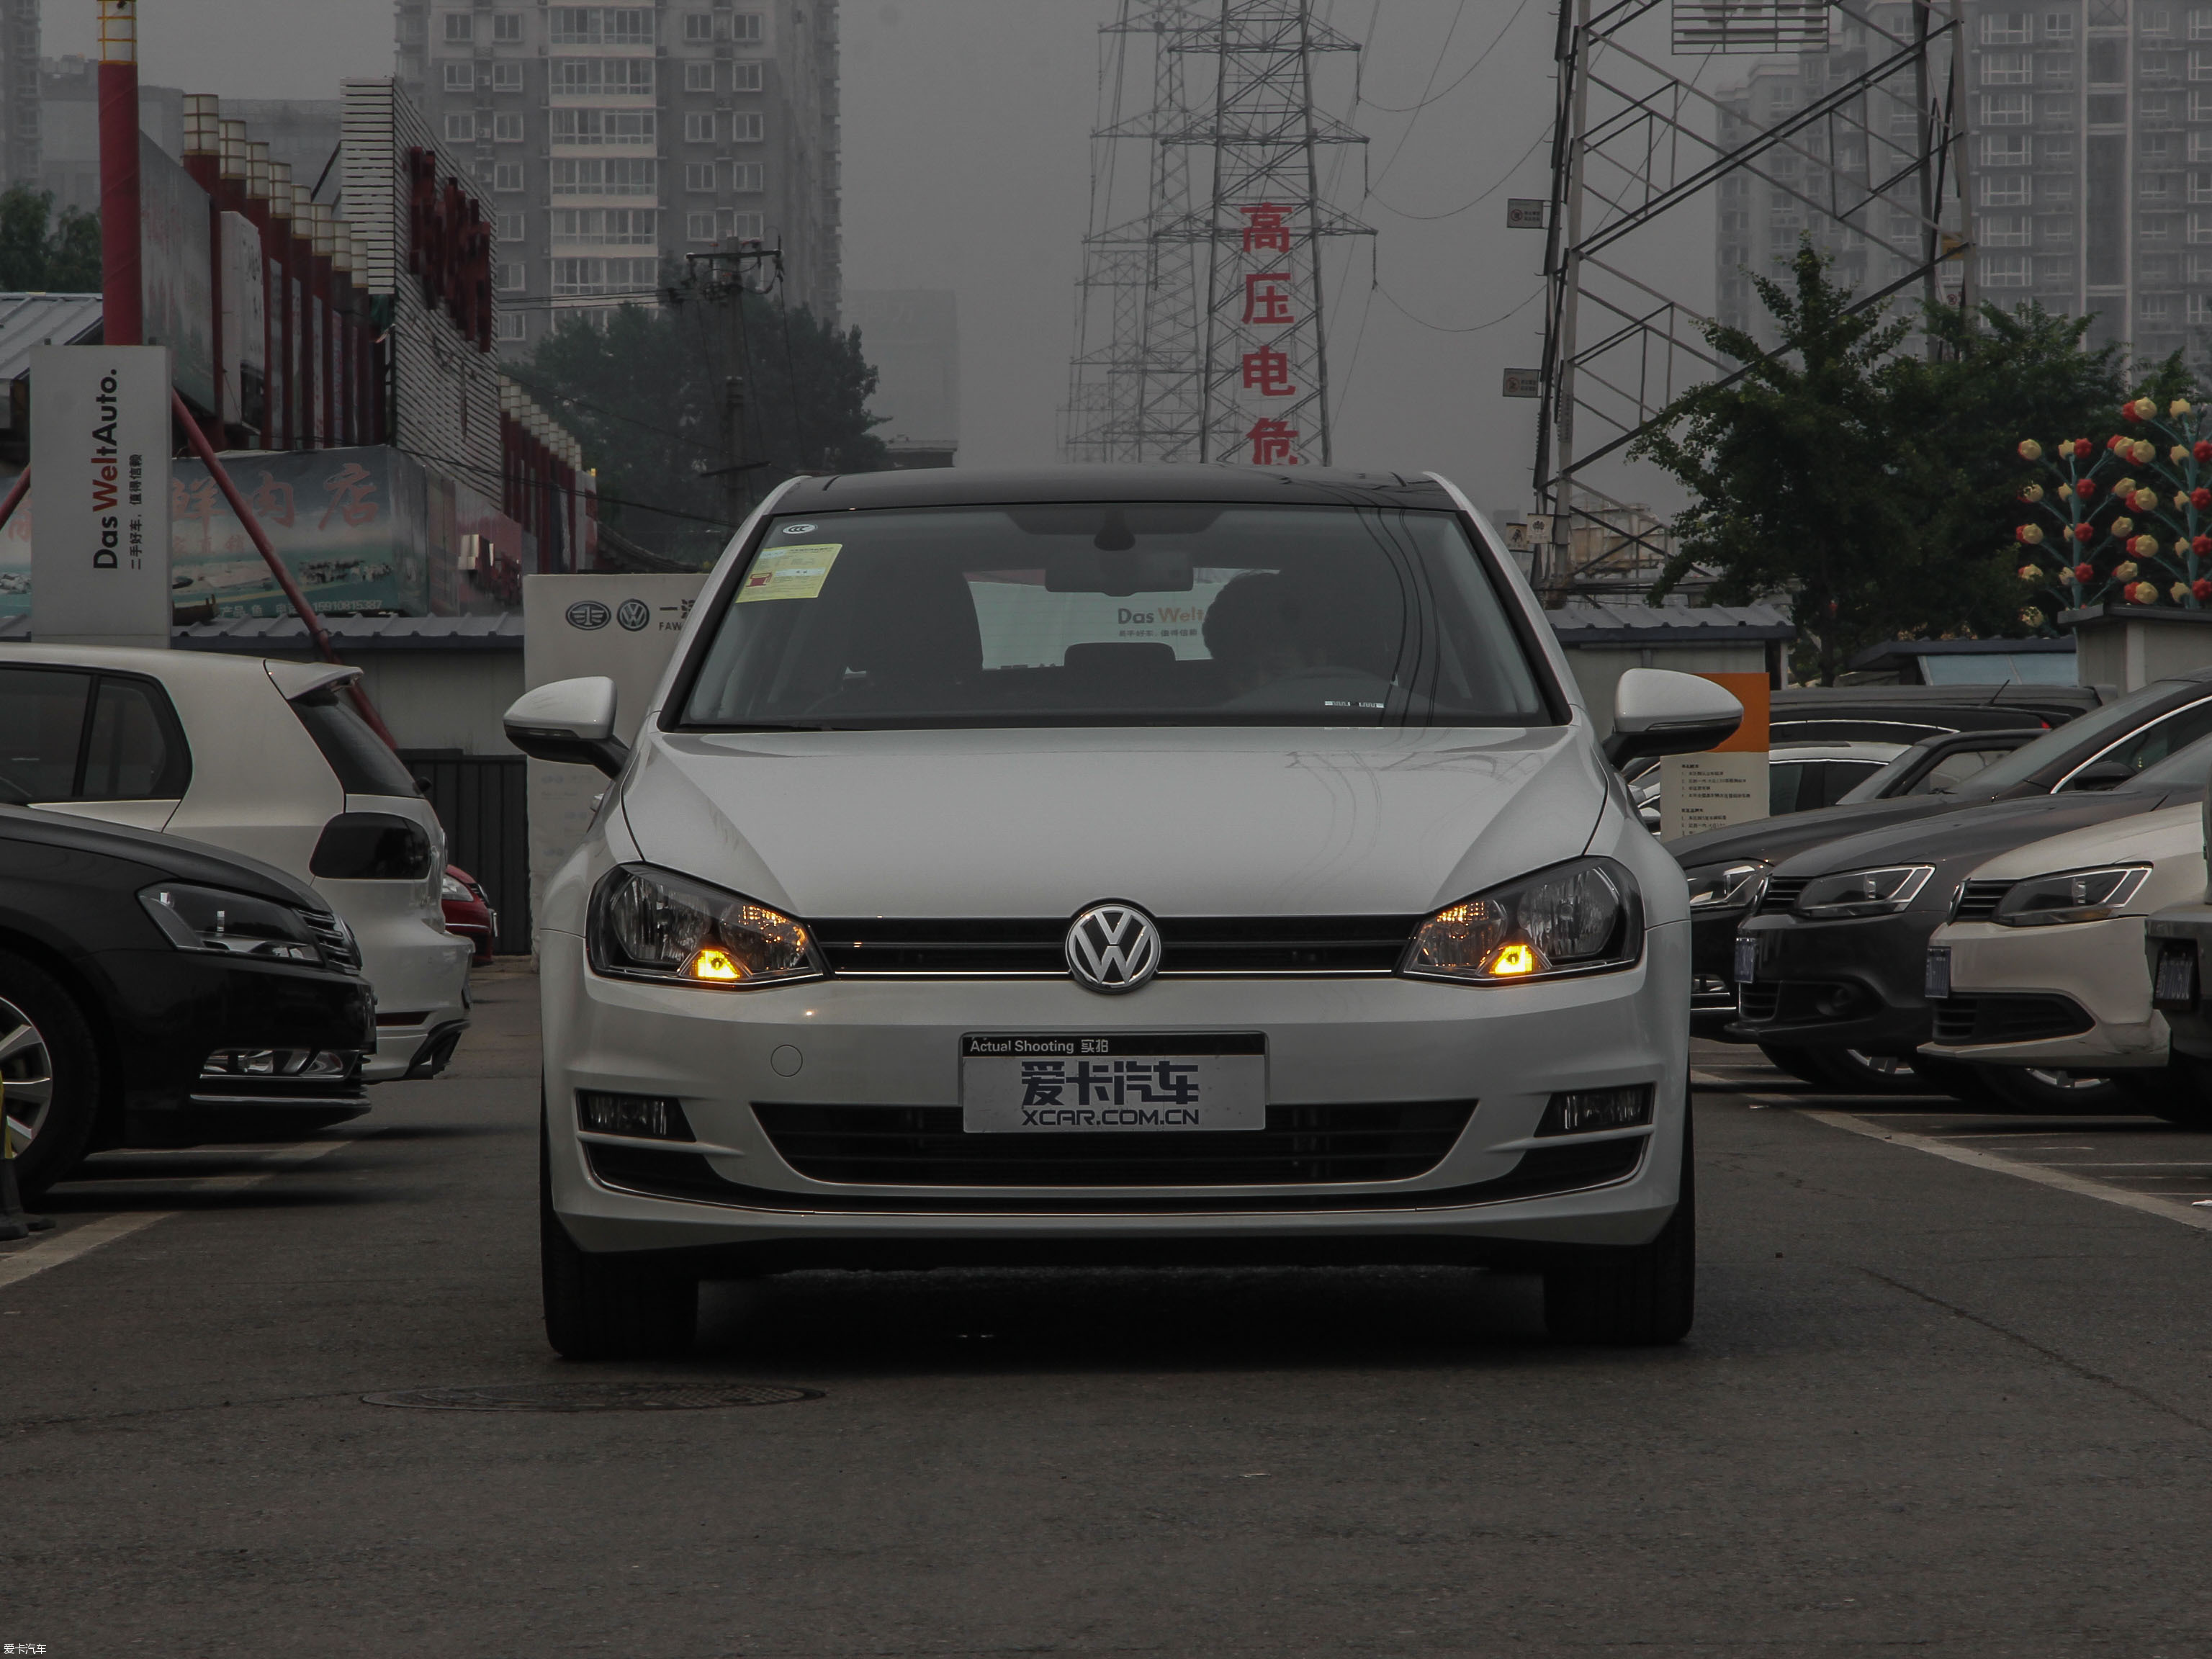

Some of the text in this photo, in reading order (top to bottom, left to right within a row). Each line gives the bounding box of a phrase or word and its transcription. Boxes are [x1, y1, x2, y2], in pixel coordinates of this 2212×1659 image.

[91, 368, 118, 570] Das WeltAuto.
[1118, 608, 1155, 625] Das
[970, 1039, 1109, 1054] Actual Shooting 实拍
[1021, 1060, 1199, 1106] 爱卡汽车
[1022, 1109, 1199, 1126] XCAR.COM.CN
